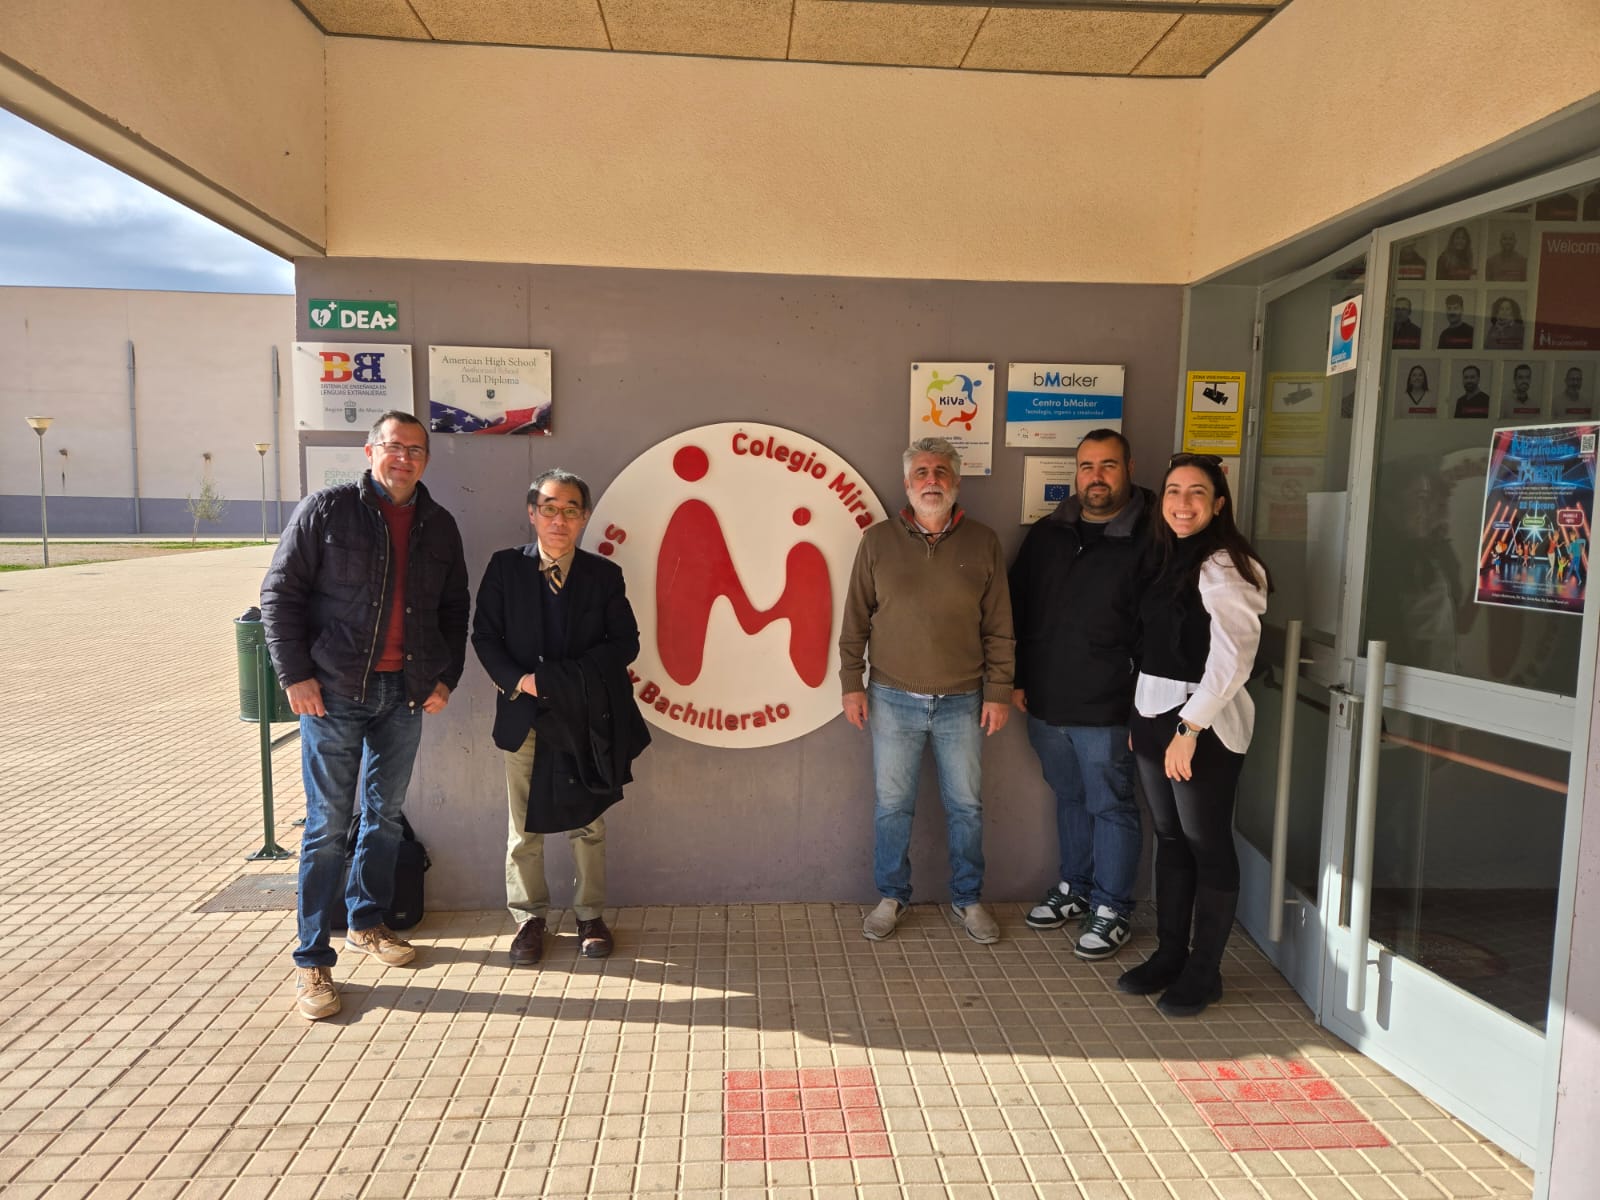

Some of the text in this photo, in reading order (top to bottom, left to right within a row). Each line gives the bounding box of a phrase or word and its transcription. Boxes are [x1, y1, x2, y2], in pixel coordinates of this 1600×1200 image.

[340, 310, 386, 329] DEA
[442, 355, 537, 367] American High School
[461, 374, 520, 386] Dual Diploma
[1033, 371, 1099, 388] bMaker
[939, 395, 965, 406] KiVa
[1032, 398, 1098, 408] Centro bMaker
[731, 432, 873, 533] Colegio Mira
[638, 680, 791, 731] Bachillerato
